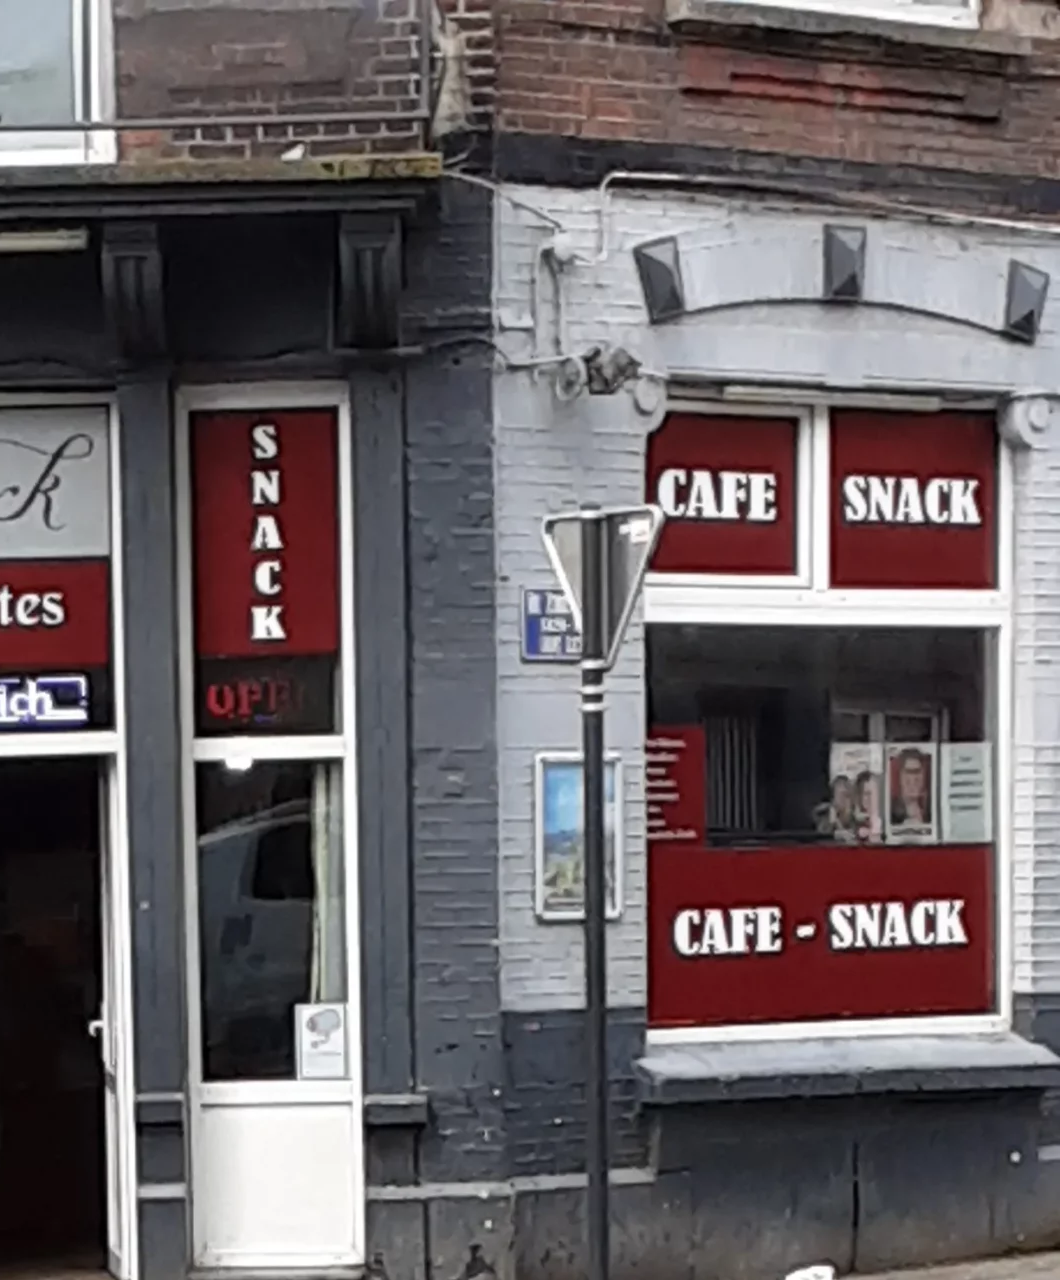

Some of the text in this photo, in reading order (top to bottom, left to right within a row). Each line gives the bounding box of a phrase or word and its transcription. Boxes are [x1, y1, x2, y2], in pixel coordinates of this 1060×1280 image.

[657, 469, 982, 524] CAFE SNACK
[252, 426, 285, 639] SNACK
[673, 907, 781, 955] CAFE
[829, 900, 967, 948] SNACK
